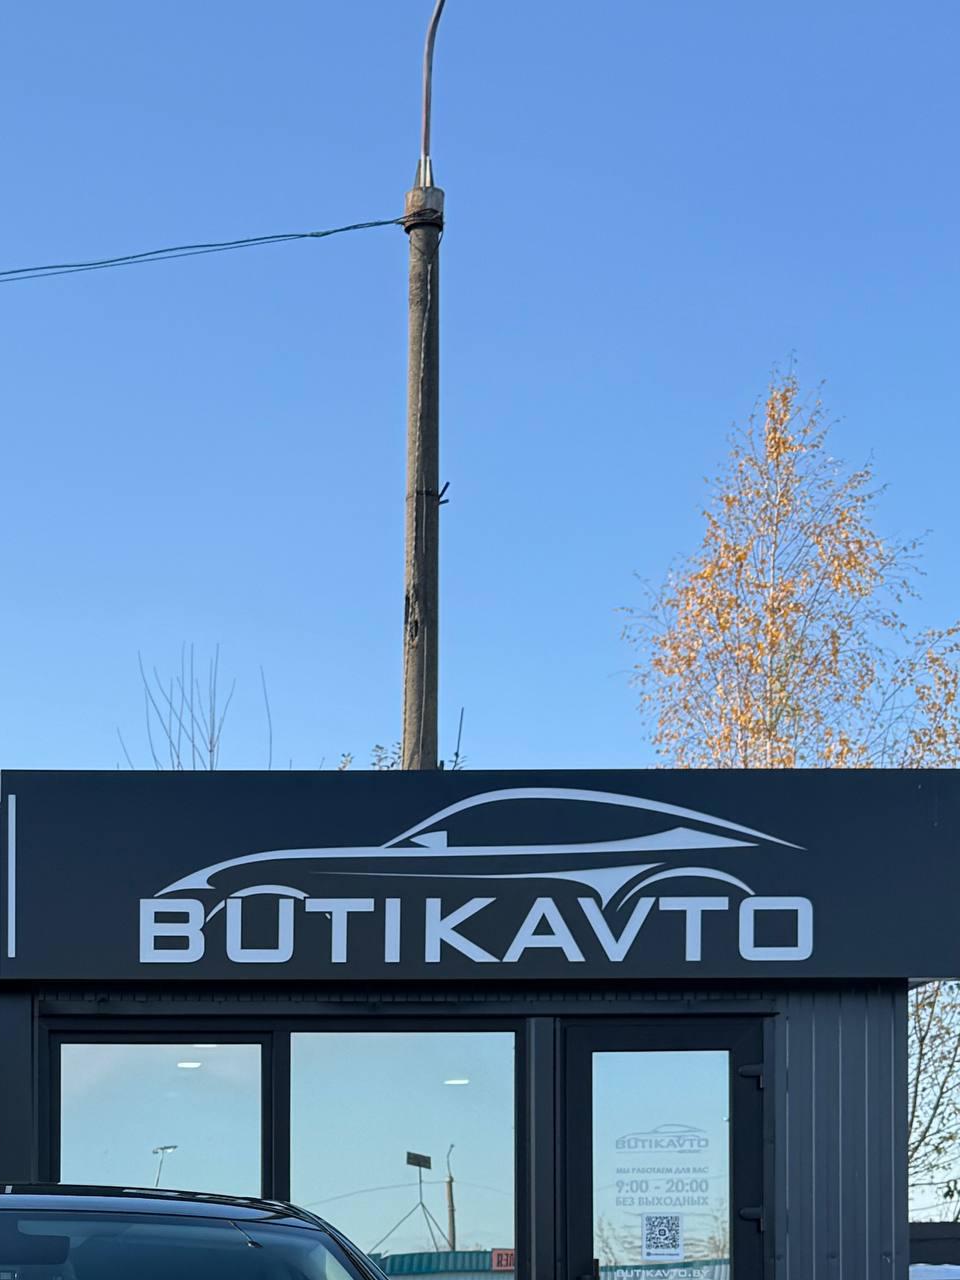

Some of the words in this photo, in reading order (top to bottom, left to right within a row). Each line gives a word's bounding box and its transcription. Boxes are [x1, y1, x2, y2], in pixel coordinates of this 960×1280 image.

[139, 896, 813, 963] BUTIKAVTO
[615, 1138, 709, 1149] BUTIKAVTO
[615, 1180, 649, 1193] 9:00
[665, 1180, 709, 1193] 20:00
[615, 1196, 634, 1206] БЕЗ
[638, 1196, 709, 1207] ВЫХОДНЫХ
